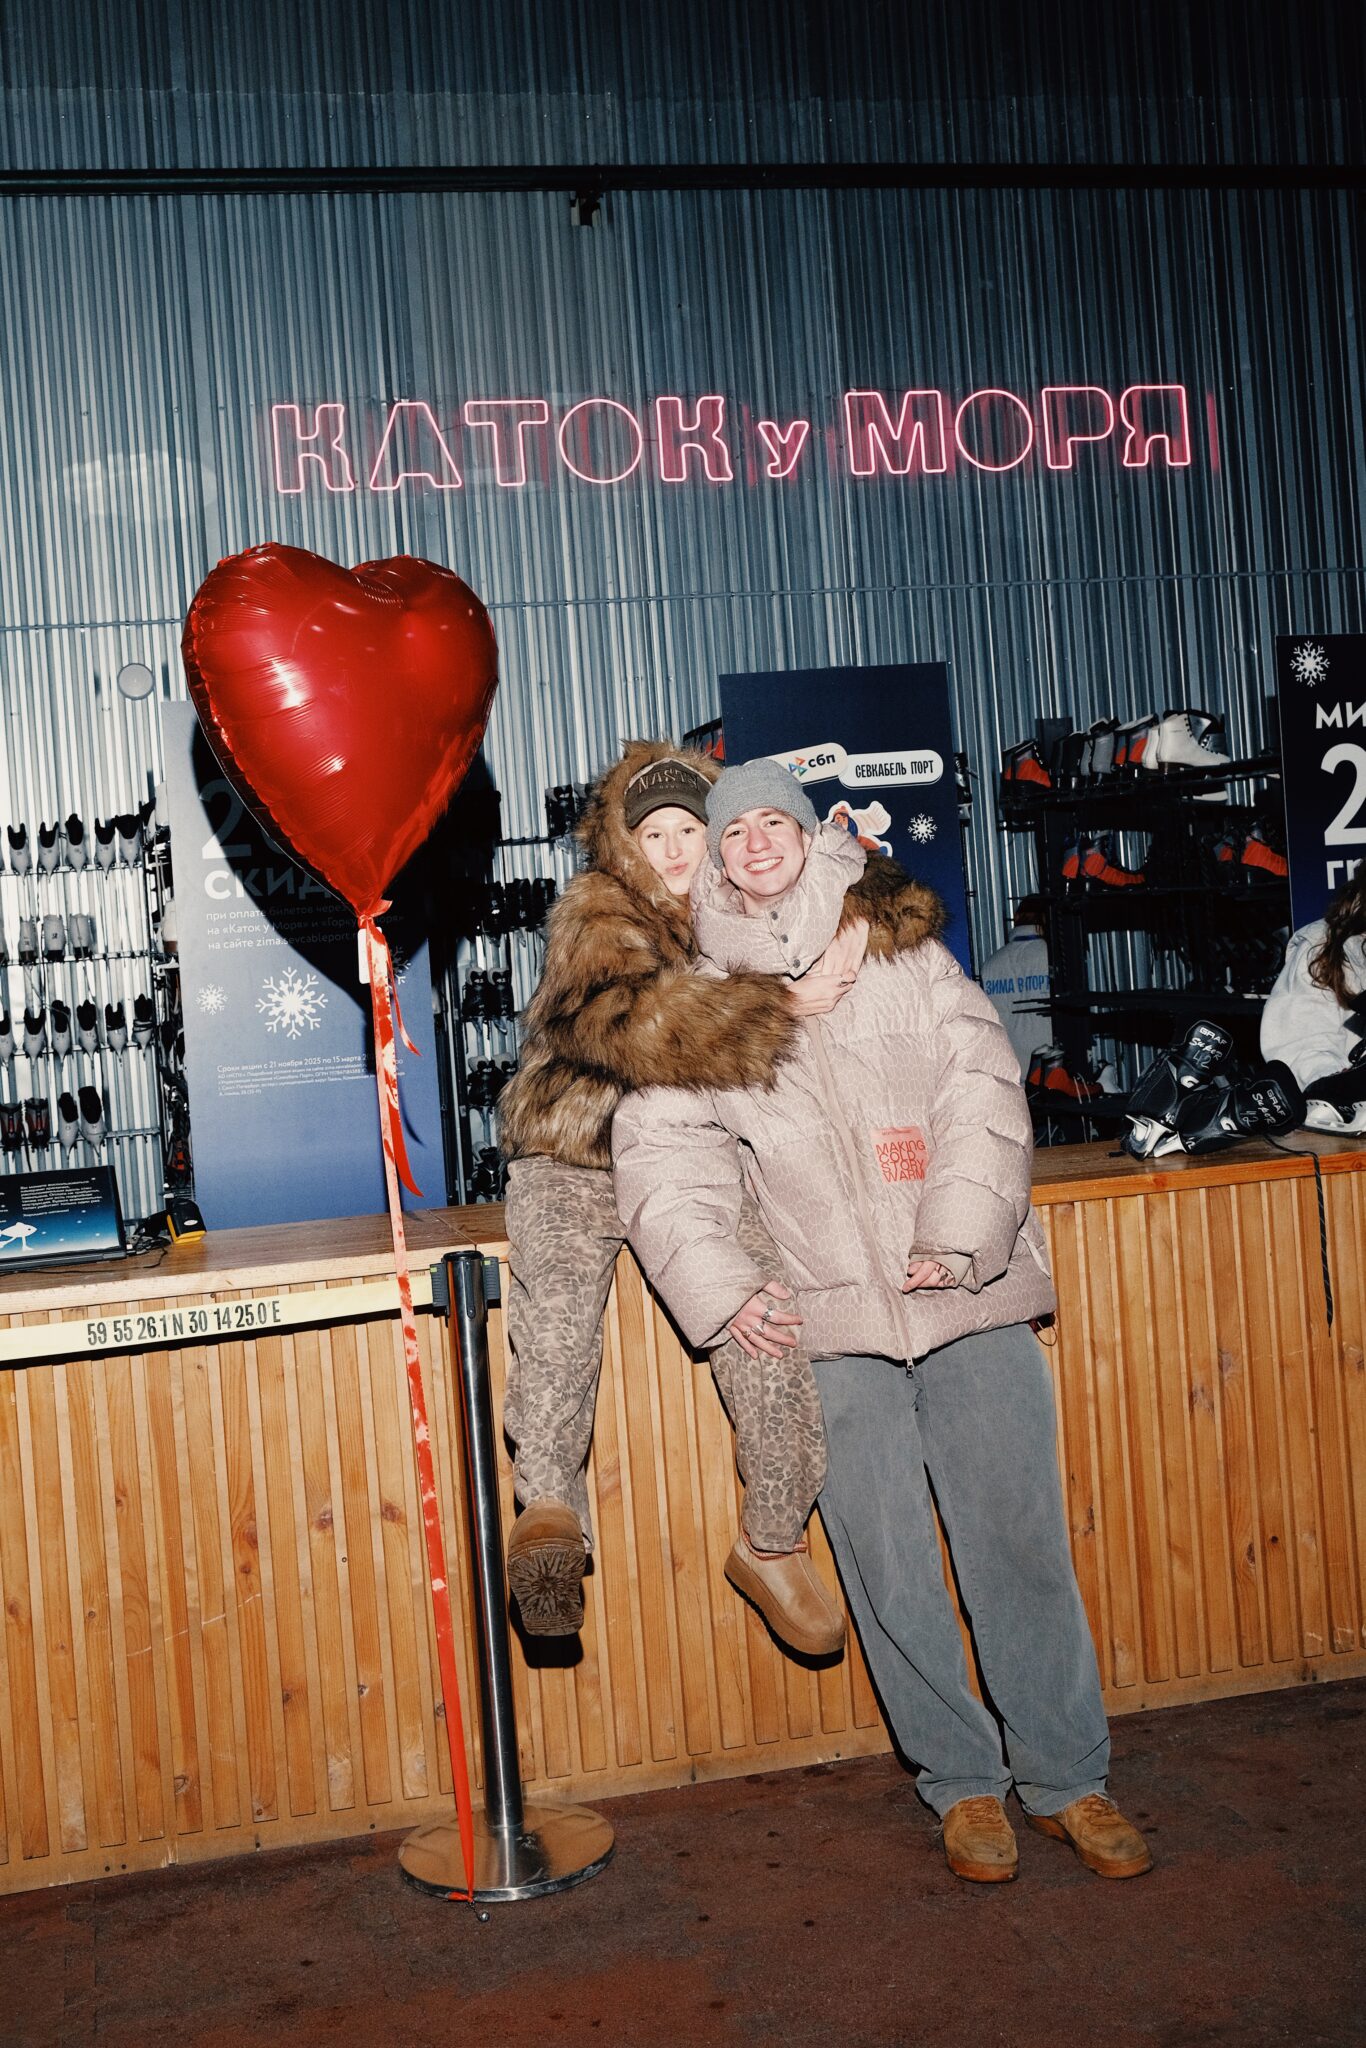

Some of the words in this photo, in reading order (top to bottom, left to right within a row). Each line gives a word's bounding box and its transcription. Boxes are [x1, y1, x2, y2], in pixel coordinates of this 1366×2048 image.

[271, 395, 734, 493] КАТОК
[844, 384, 1192, 476] МОРЯ
[855, 761, 907, 779] СЕВКАБЕЛЬ
[910, 759, 935, 775] ПОРТ
[206, 911, 227, 922] при
[229, 909, 267, 920] оплате
[207, 927, 220, 936] на
[208, 941, 221, 950] на
[223, 938, 254, 949] сайте
[256, 931, 357, 948] zima.sevcableport.r
[985, 978, 1015, 996] ЗИМА
[1017, 976, 1024, 993] В
[1025, 974, 1051, 991] ПОРТ
[1199, 1026, 1227, 1045] GRAF
[304, 1057, 321, 1066] 2025
[332, 1056, 341, 1064] 15
[1266, 1088, 1287, 1117] GRAF
